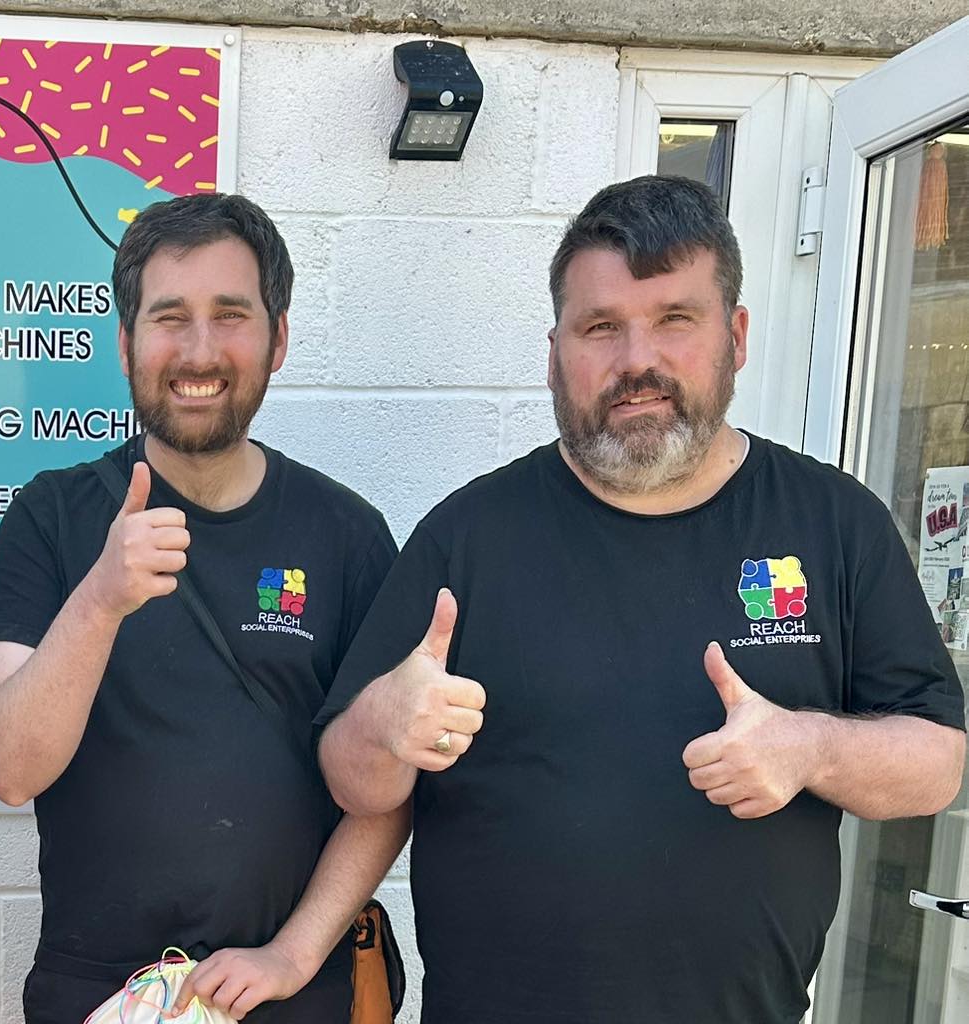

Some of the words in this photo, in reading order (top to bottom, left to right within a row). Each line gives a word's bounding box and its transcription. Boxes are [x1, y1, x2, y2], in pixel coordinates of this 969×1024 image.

[5, 281, 112, 317] MAKES
[258, 612, 300, 628] REACH
[749, 619, 806, 637] REACH
[730, 636, 765, 648] SOCIAL
